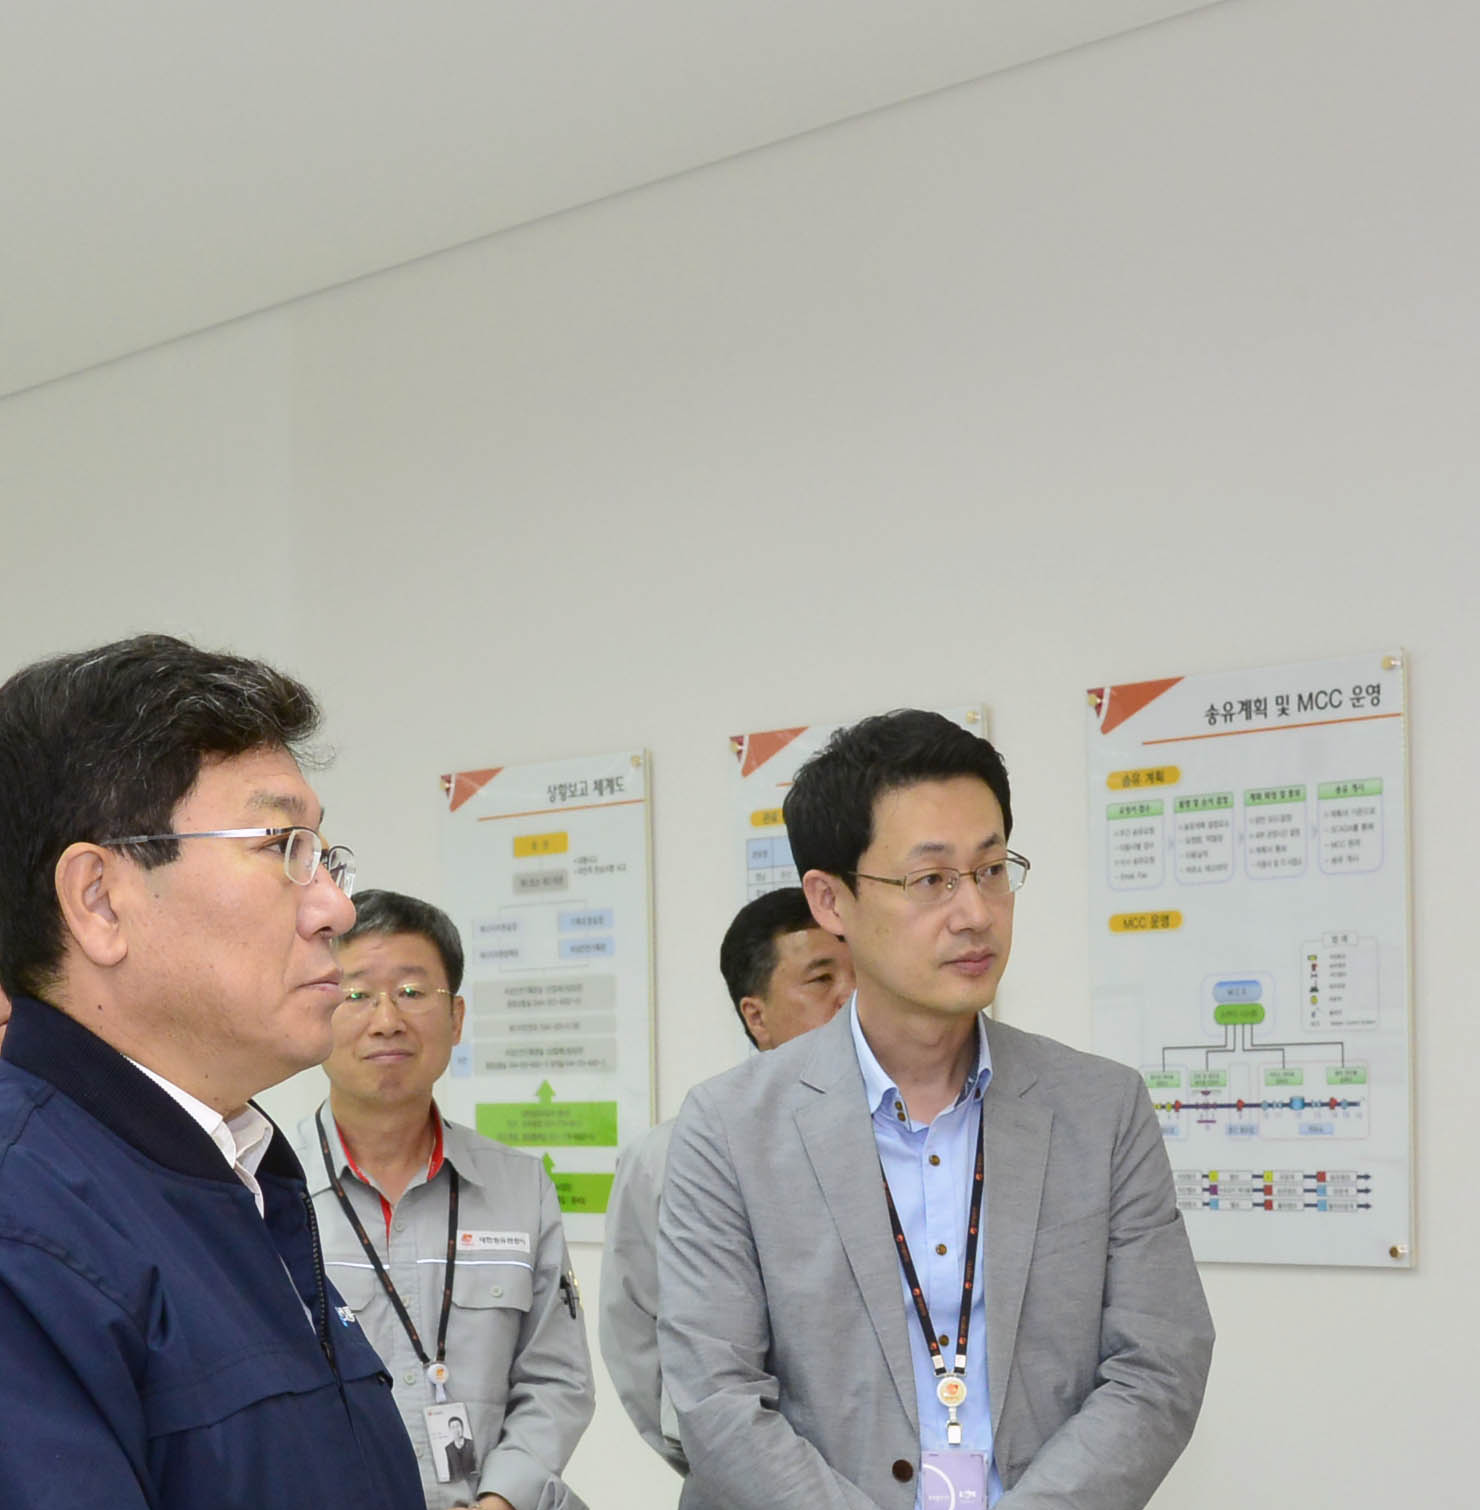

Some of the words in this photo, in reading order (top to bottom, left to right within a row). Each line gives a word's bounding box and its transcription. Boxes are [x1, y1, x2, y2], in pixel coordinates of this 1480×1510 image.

[1204, 697, 1268, 726] 송유계획
[1275, 694, 1290, 717] 및
[1297, 688, 1343, 713] MCC
[1349, 683, 1382, 709] 운영
